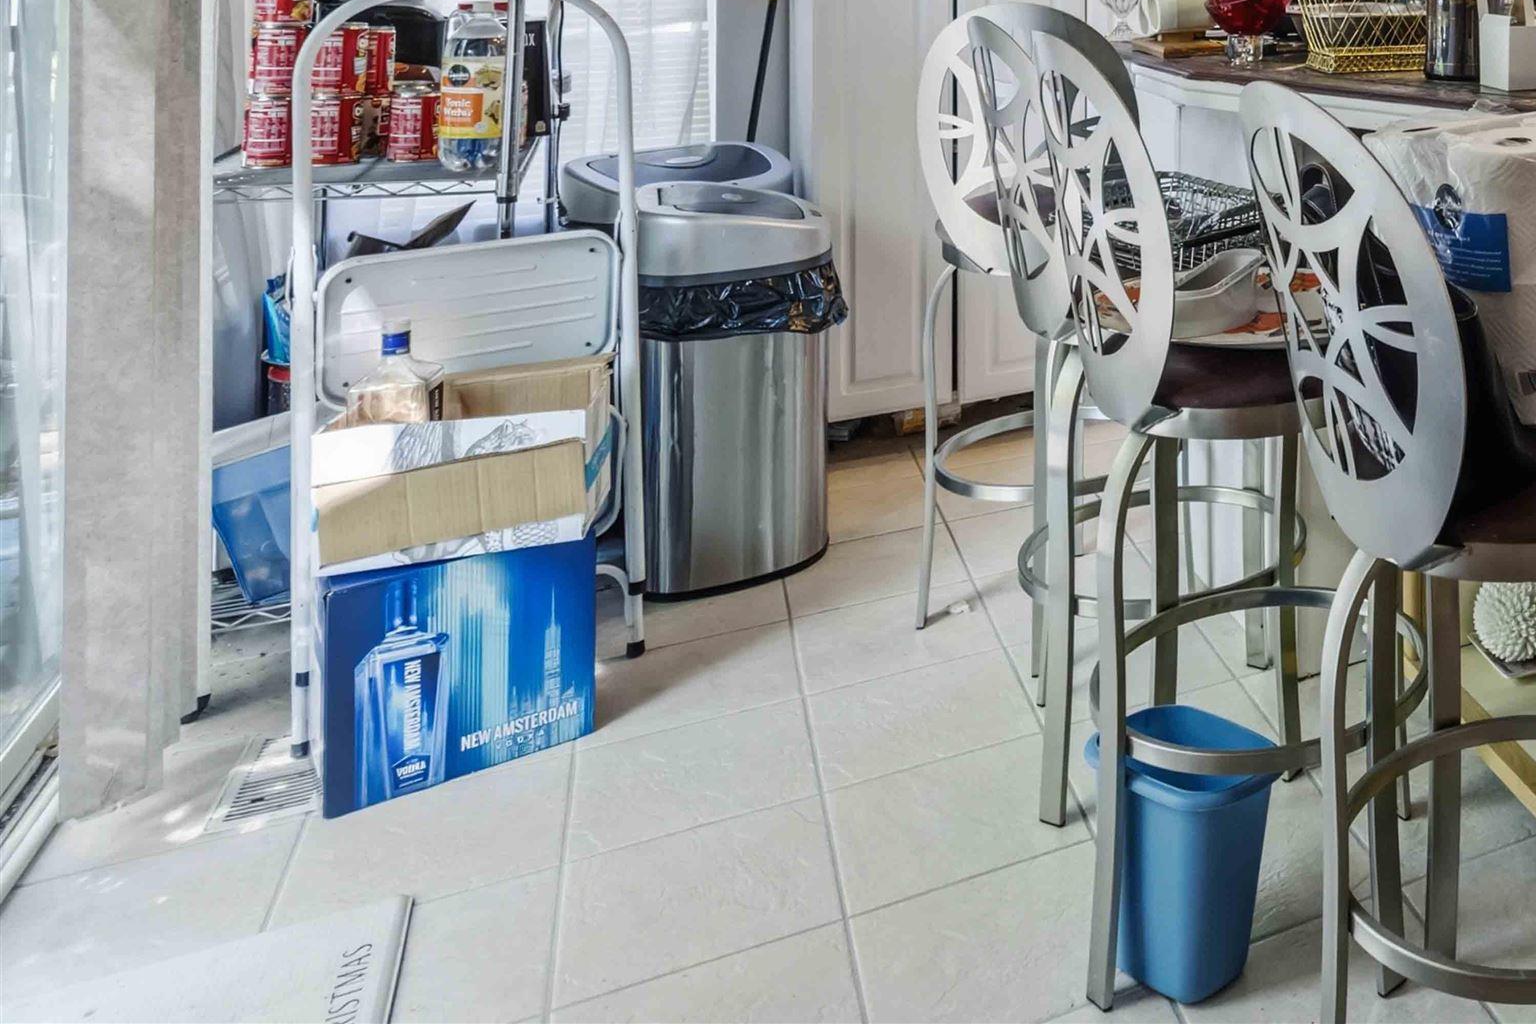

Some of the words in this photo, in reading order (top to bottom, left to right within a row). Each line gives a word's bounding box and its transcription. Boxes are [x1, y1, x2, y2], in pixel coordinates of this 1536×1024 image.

[443, 106, 473, 118] Water
[444, 97, 472, 108] Tonic
[404, 658, 422, 683] NEW
[403, 682, 422, 751] AMSTERDAM
[460, 727, 492, 753] NEW
[494, 700, 578, 739] AMSTERDAM
[396, 760, 427, 778] VODKA
